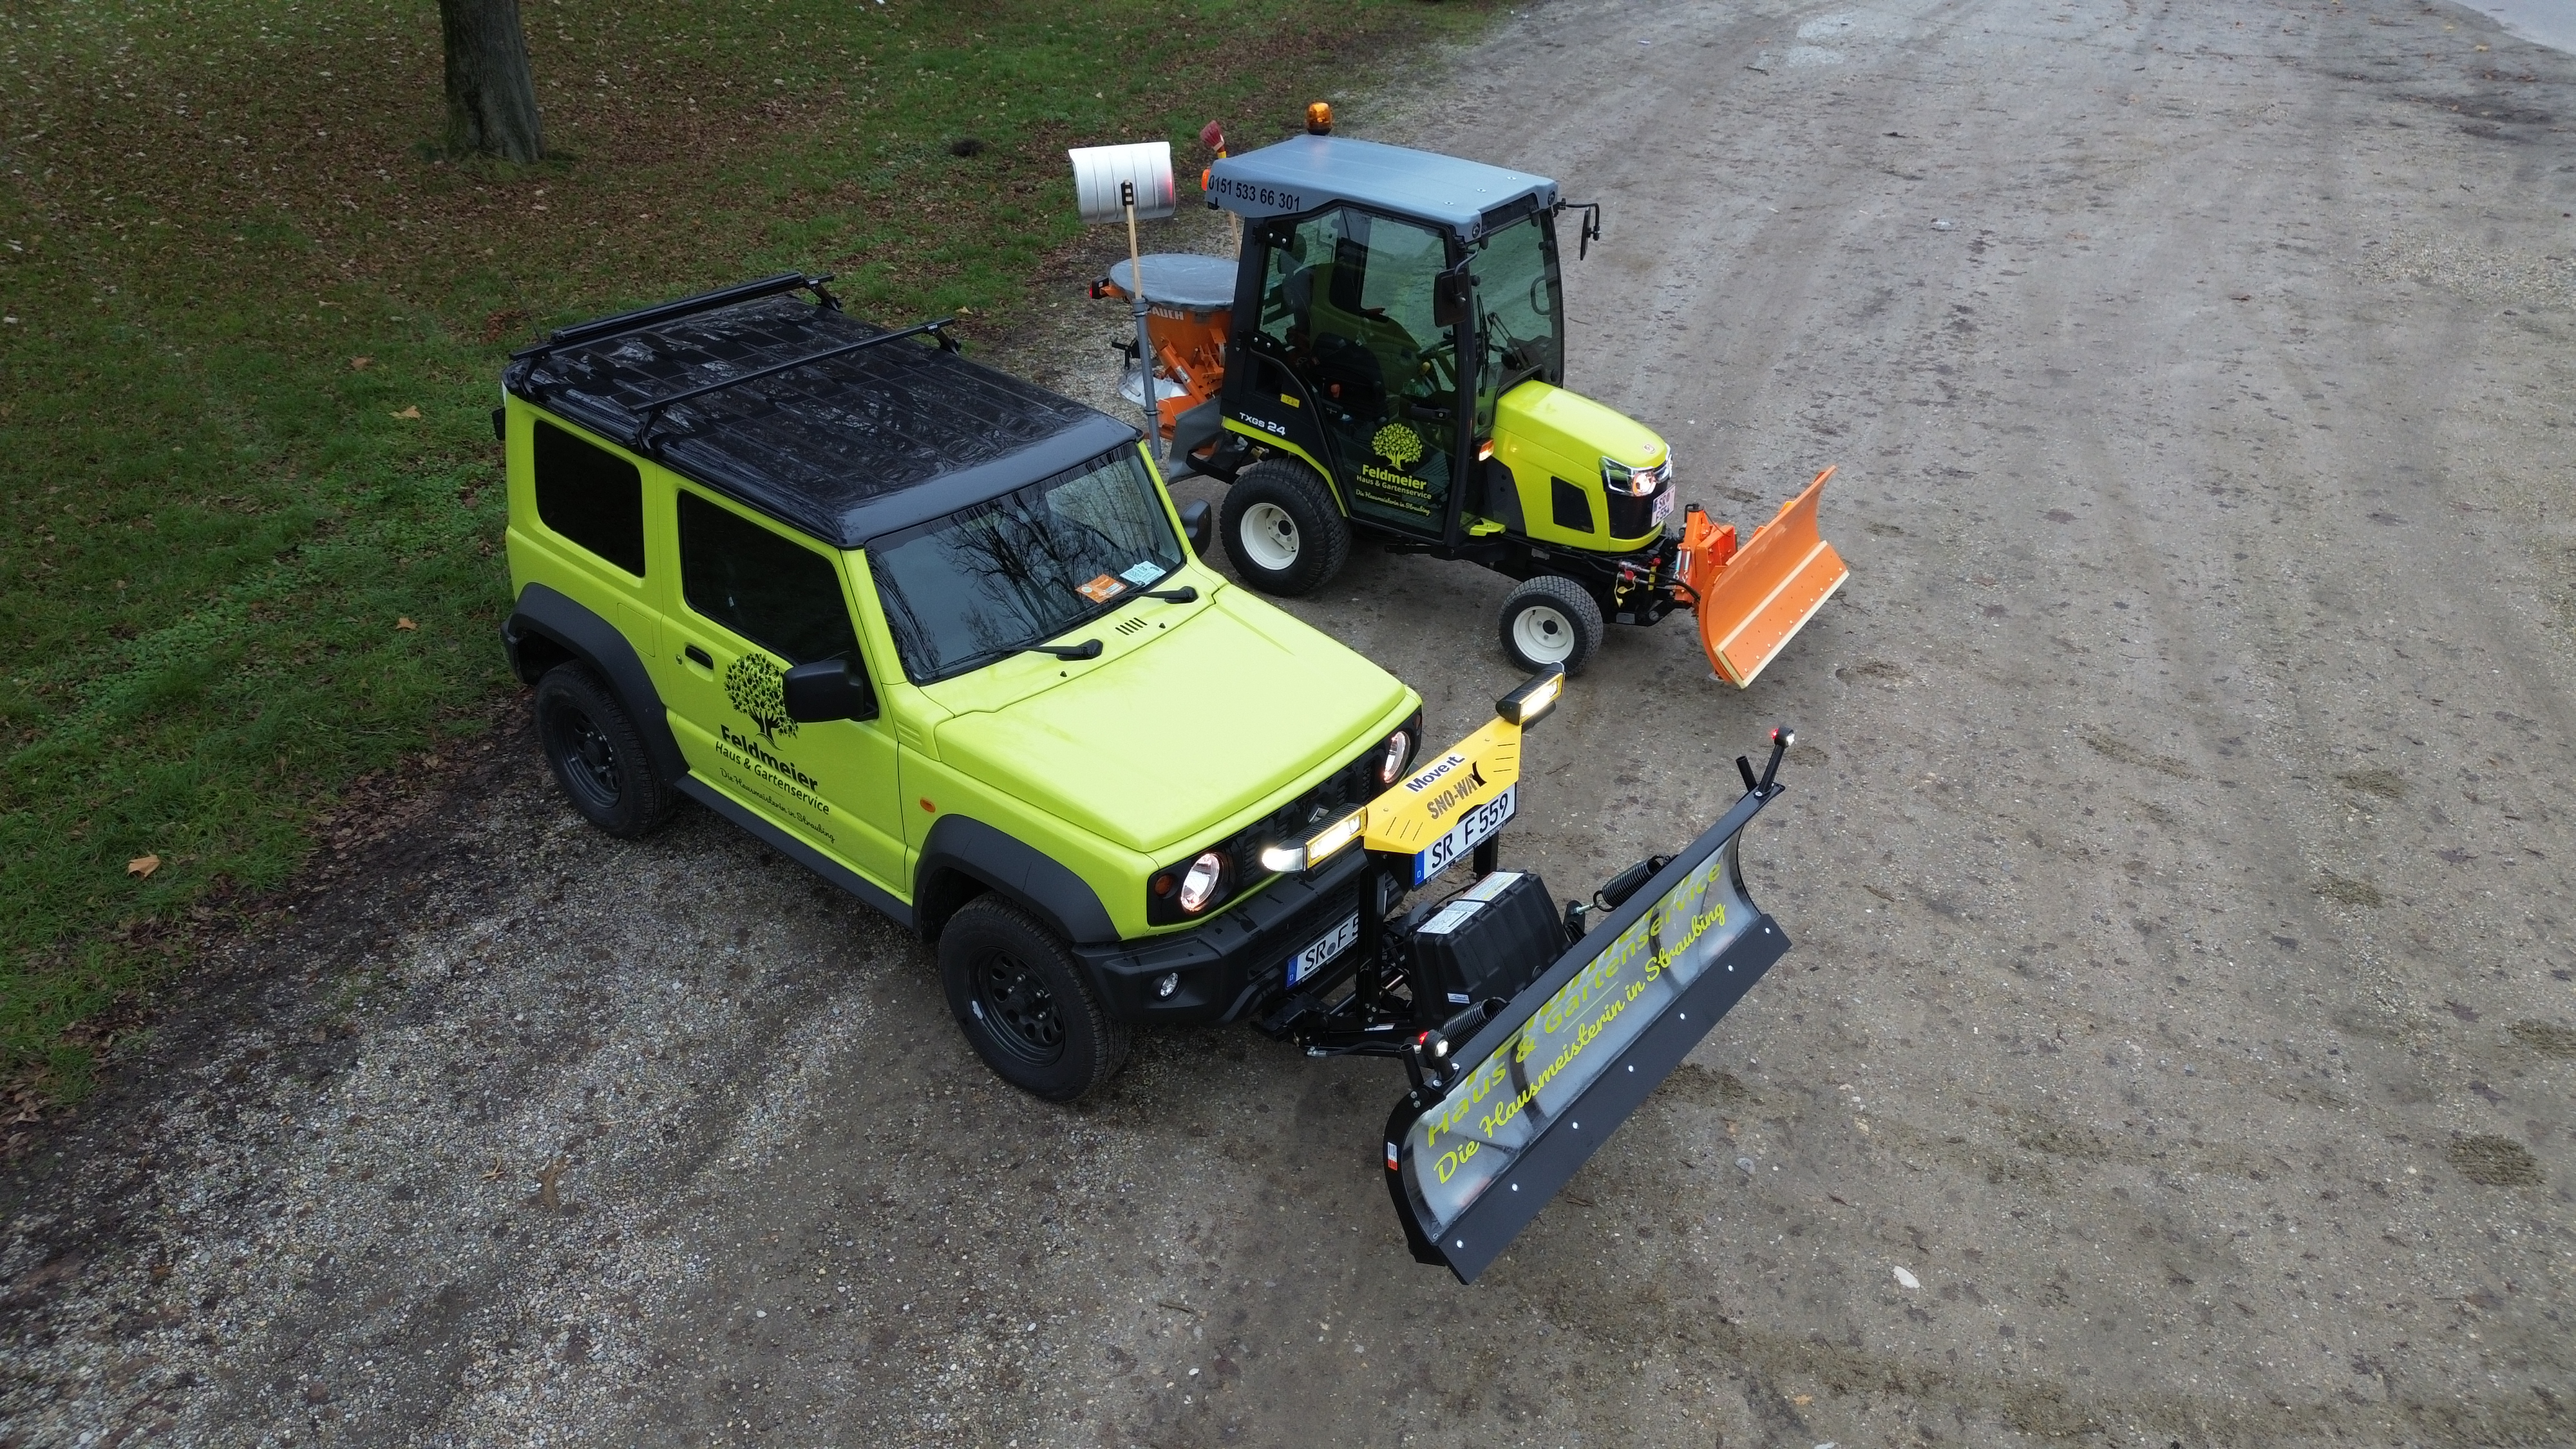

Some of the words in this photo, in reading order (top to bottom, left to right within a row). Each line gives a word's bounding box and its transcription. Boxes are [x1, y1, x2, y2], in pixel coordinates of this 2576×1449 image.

[1208, 175, 1232, 195] 0151
[1235, 182, 1256, 201] 533
[1260, 188, 1274, 205] 66
[1278, 193, 1300, 211] 301
[1148, 306, 1184, 321] AUCH
[1239, 412, 1265, 428] TXGS
[1267, 421, 1286, 435] 24
[1356, 475, 1374, 485] Haus
[1381, 482, 1432, 500] Gartenservice
[1362, 464, 1427, 490] Feldmeier
[715, 741, 741, 765] Haus
[743, 757, 752, 771] &
[754, 764, 829, 815] Gartenservice
[720, 723, 819, 792] Feldmeier
[1405, 764, 1450, 792] Move
[719, 767, 734, 782] Die
[787, 808, 797, 819] in
[796, 812, 835, 844] Straubing
[1426, 760, 1488, 820] SNO-WAY
[1432, 833, 1454, 869] SR
[1464, 816, 1475, 846] F
[1479, 793, 1508, 833] 559
[1304, 939, 1327, 972] SR
[1337, 922, 1349, 949] F
[1428, 1061, 1507, 1149] Haus
[1515, 1035, 1537, 1063] &
[1546, 864, 1721, 1034] Gartenservice
[1433, 1141, 1480, 1184] Die
[1479, 1000, 1625, 1139] Hausmeisterin
[1624, 980, 1645, 1001] in
[1644, 903, 1726, 982] Straubing
